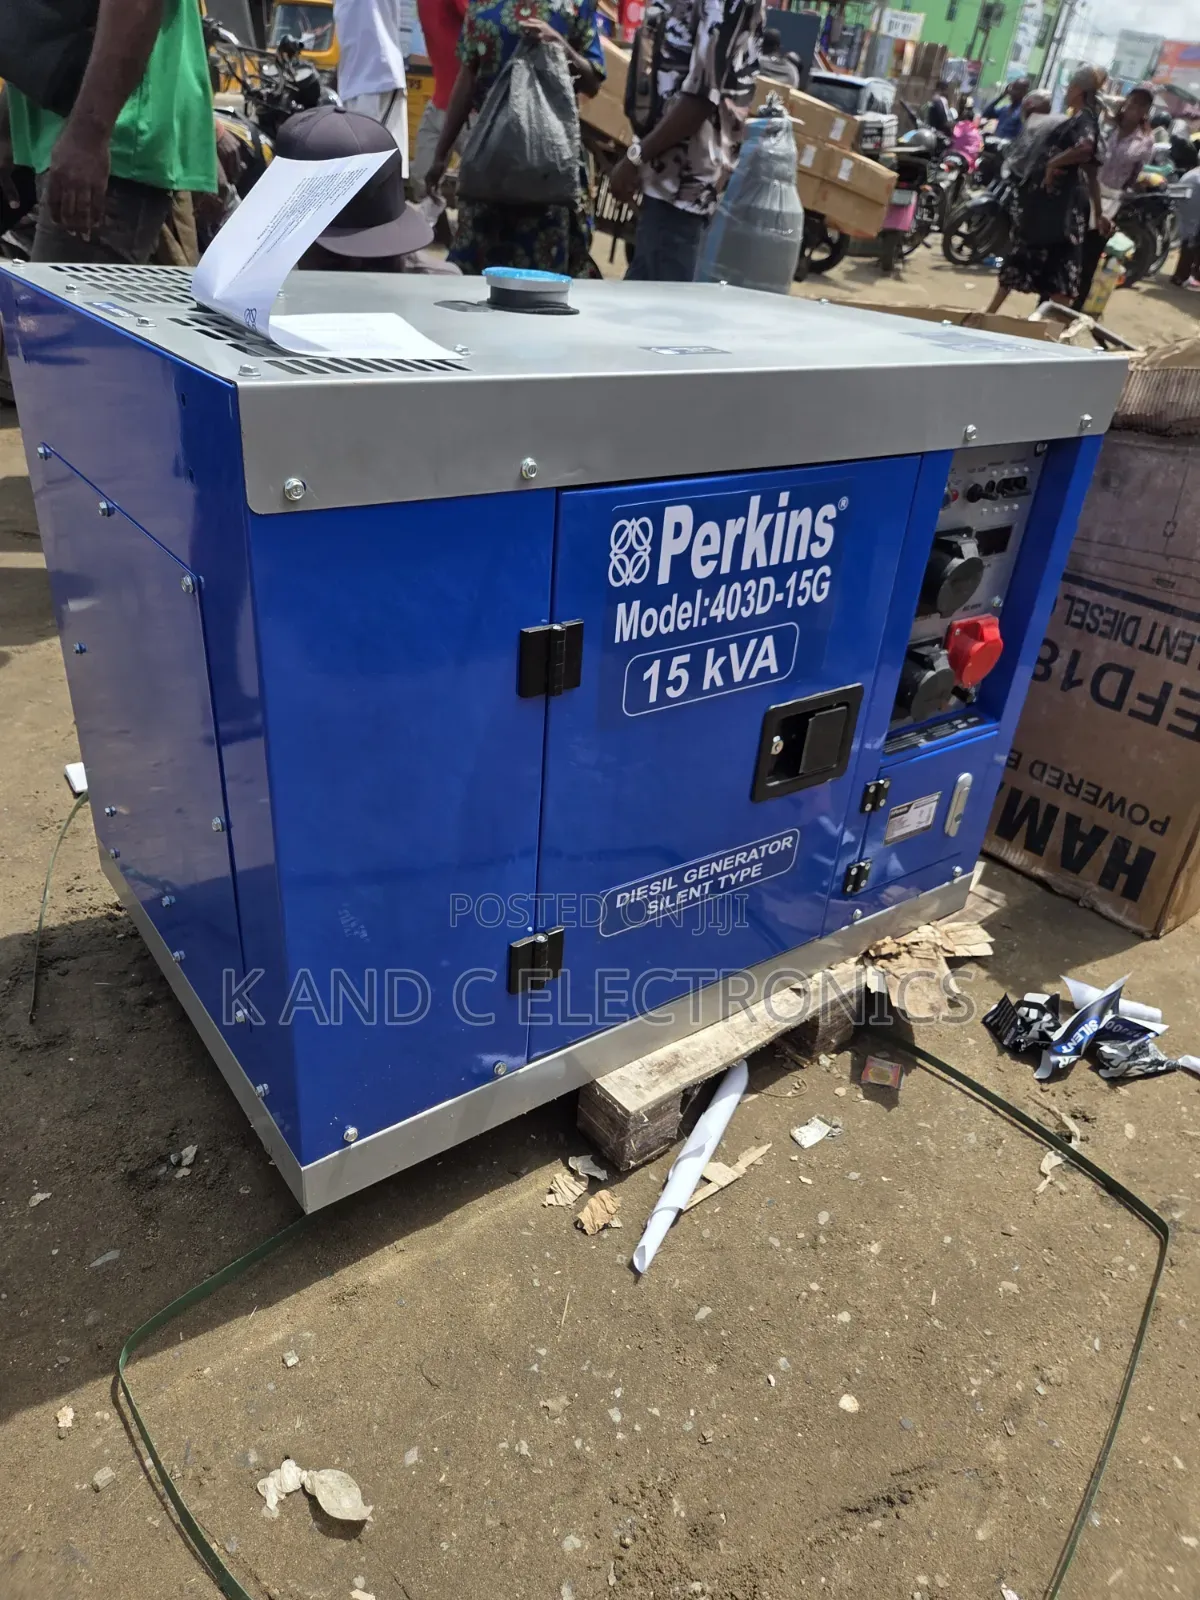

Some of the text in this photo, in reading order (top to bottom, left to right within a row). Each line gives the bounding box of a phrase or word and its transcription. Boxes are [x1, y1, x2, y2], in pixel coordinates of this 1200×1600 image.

[614, 565, 832, 643] Model:403D-15G
[1064, 593, 1142, 647] DIESEL
[642, 635, 779, 703] 15 kVA
[1029, 759, 1172, 836] POWERED
[615, 835, 794, 909] DIESIL GENERATOR
[995, 781, 1157, 902] HAM
[646, 863, 763, 915] SILENT TYPE
[1061, 1019, 1099, 1054] SILENT
